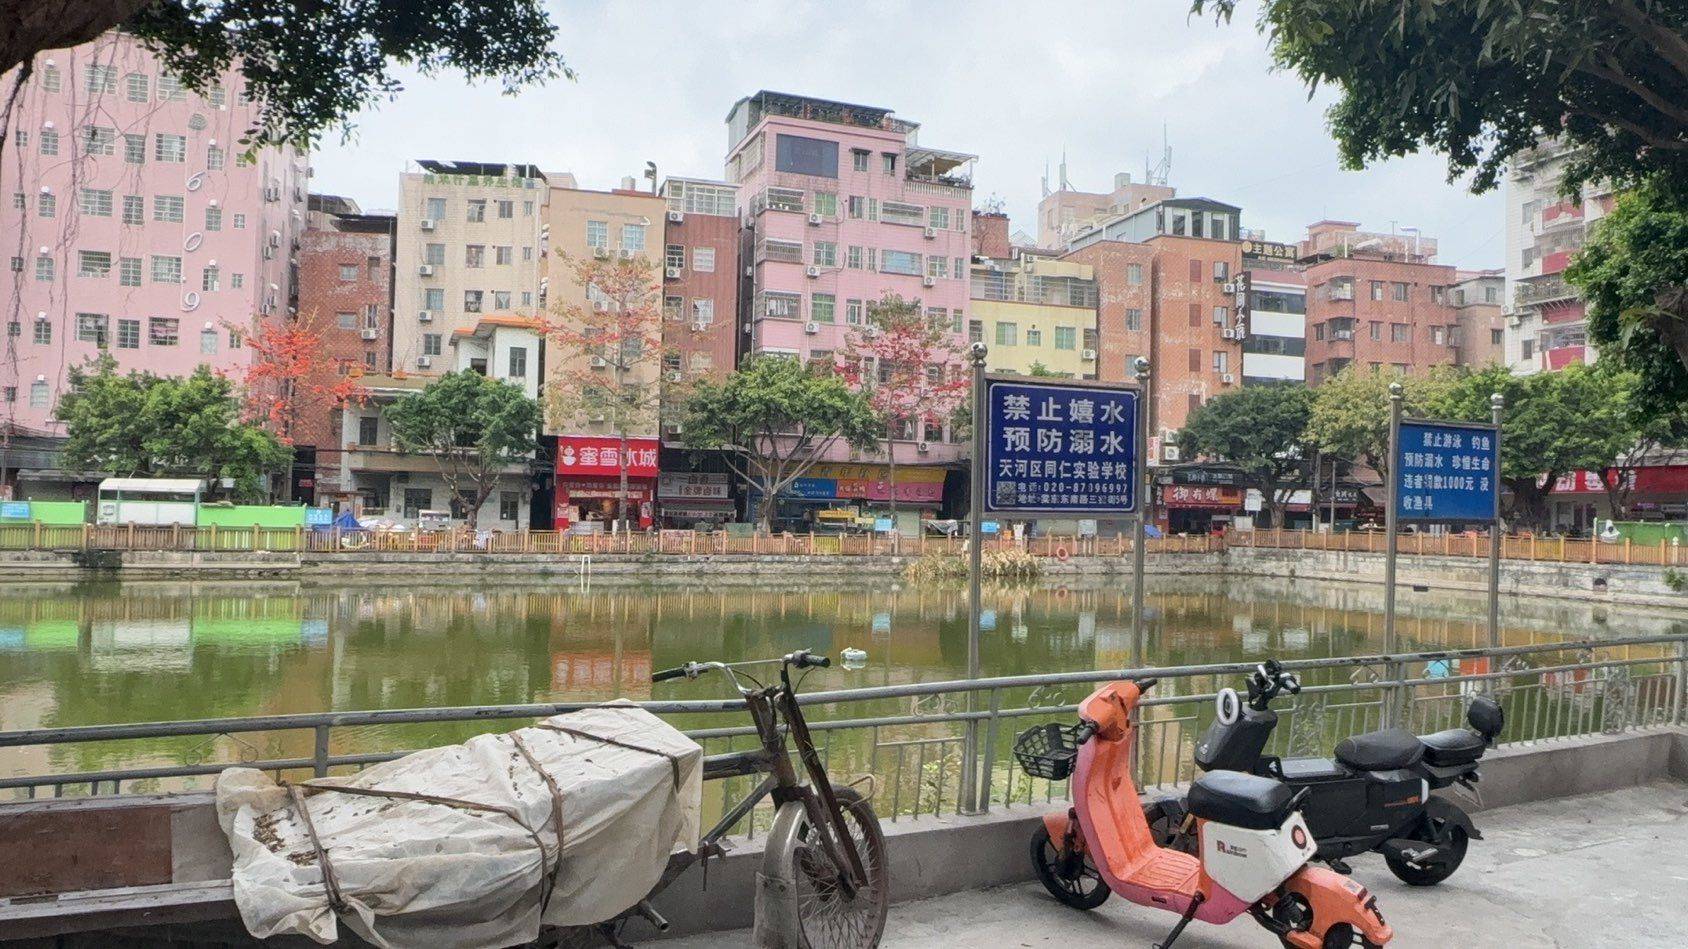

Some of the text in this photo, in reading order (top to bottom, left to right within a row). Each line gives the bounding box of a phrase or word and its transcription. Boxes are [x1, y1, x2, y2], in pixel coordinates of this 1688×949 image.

[1003, 394, 1125, 425] 禁止嬉水
[1002, 426, 1125, 455] 预防溺水
[1423, 432, 1490, 451] 禁止游泳 钓鱼
[579, 446, 658, 467] 蜜雪冰城
[1404, 452, 1490, 471] 预防溺水 珍惜生命
[999, 459, 1127, 480] 天河区同仁实验学校
[1403, 474, 1474, 491] 违者罚款1000元
[1403, 495, 1433, 510] 收渔具
